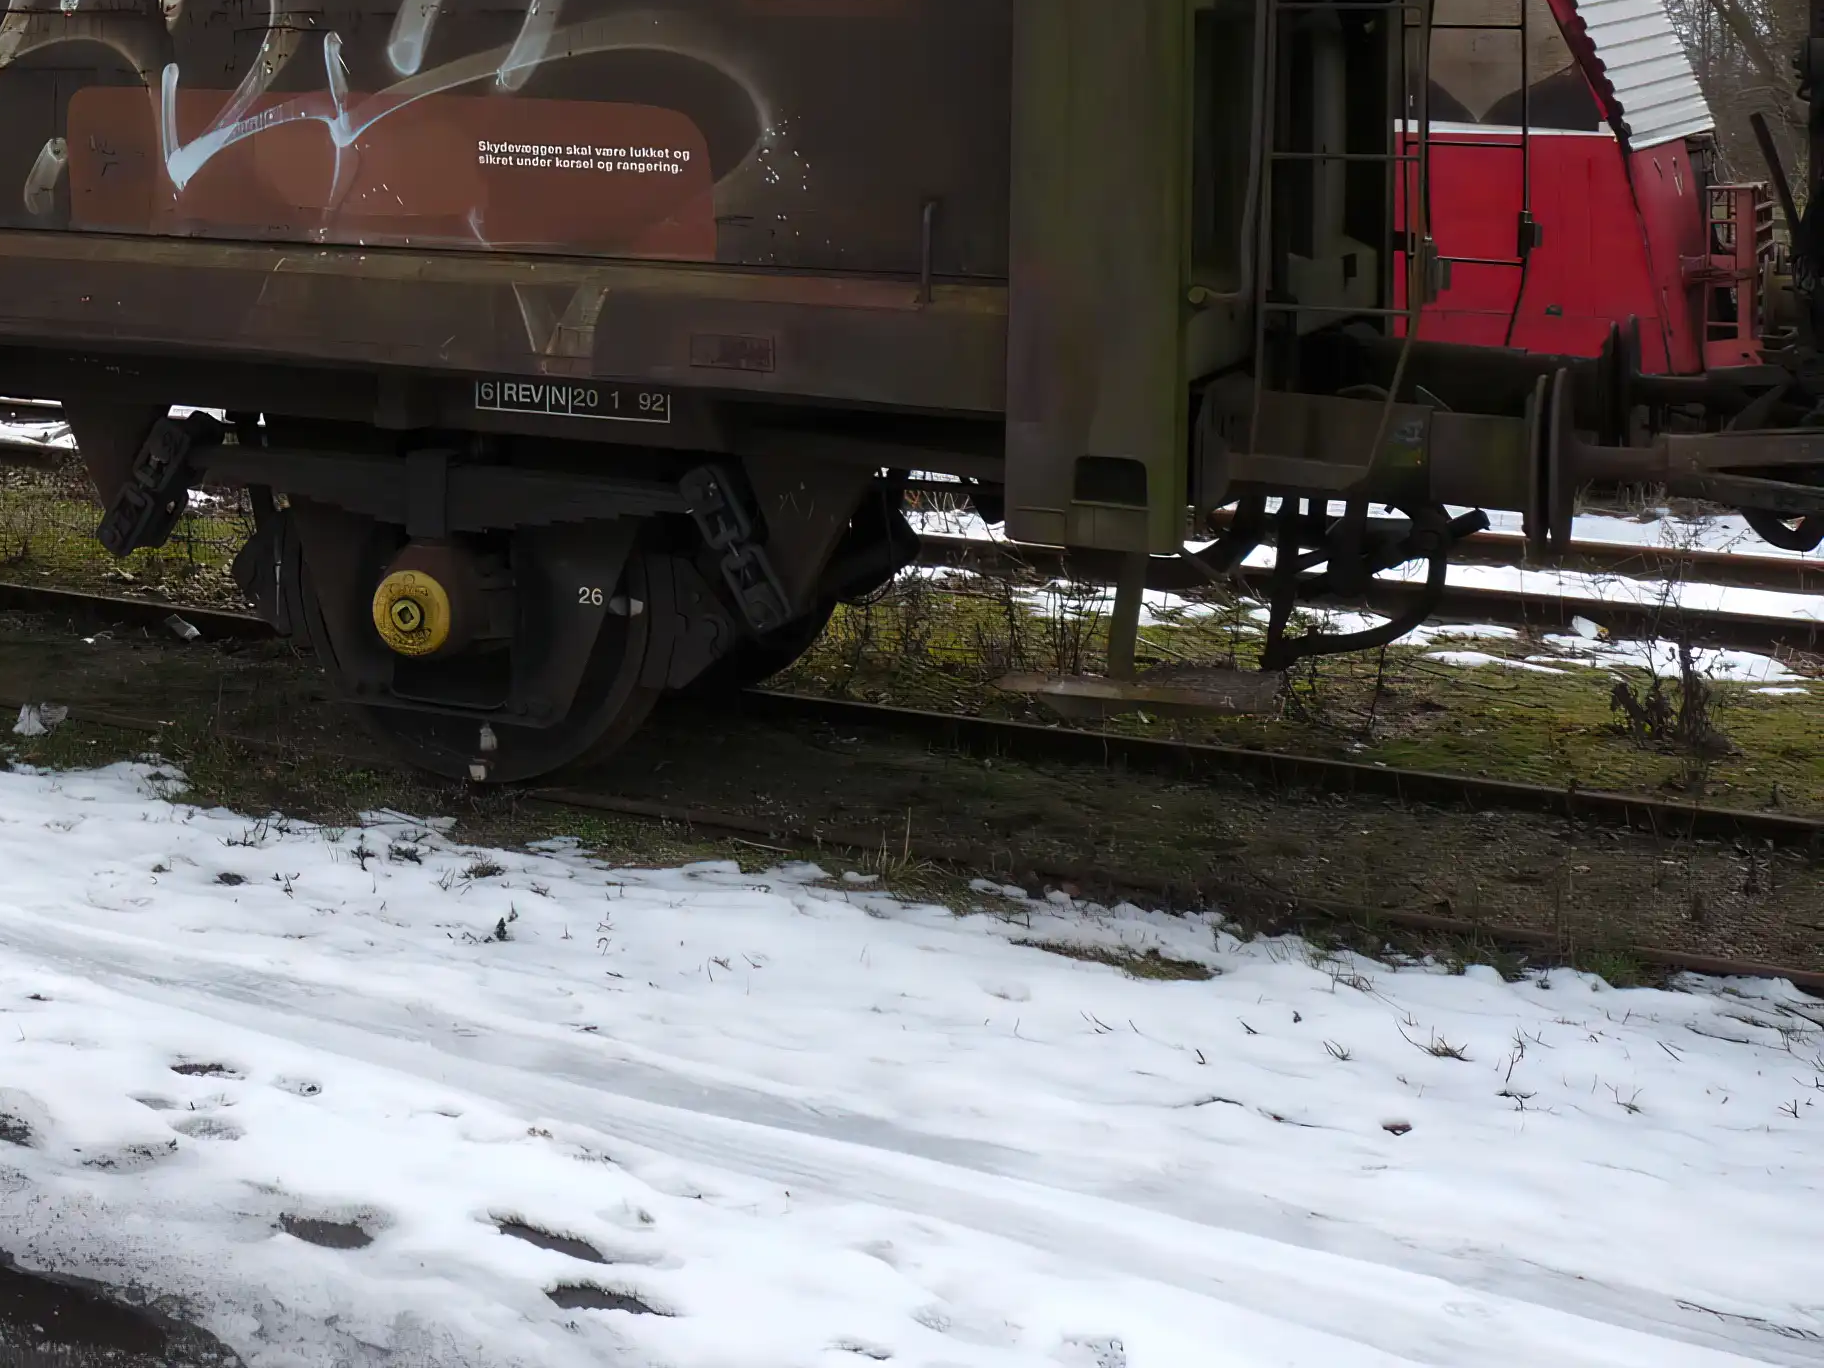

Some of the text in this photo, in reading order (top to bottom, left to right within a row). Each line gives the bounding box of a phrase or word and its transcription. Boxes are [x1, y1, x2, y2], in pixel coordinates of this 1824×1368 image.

[566, 144, 592, 155] skal
[630, 146, 670, 159] lukket
[673, 150, 690, 161] og
[478, 154, 514, 166] sikret
[516, 156, 553, 168] under
[597, 161, 613, 172] og
[480, 382, 666, 413] 6 REV N 20 1 92
[578, 586, 604, 606] 26
